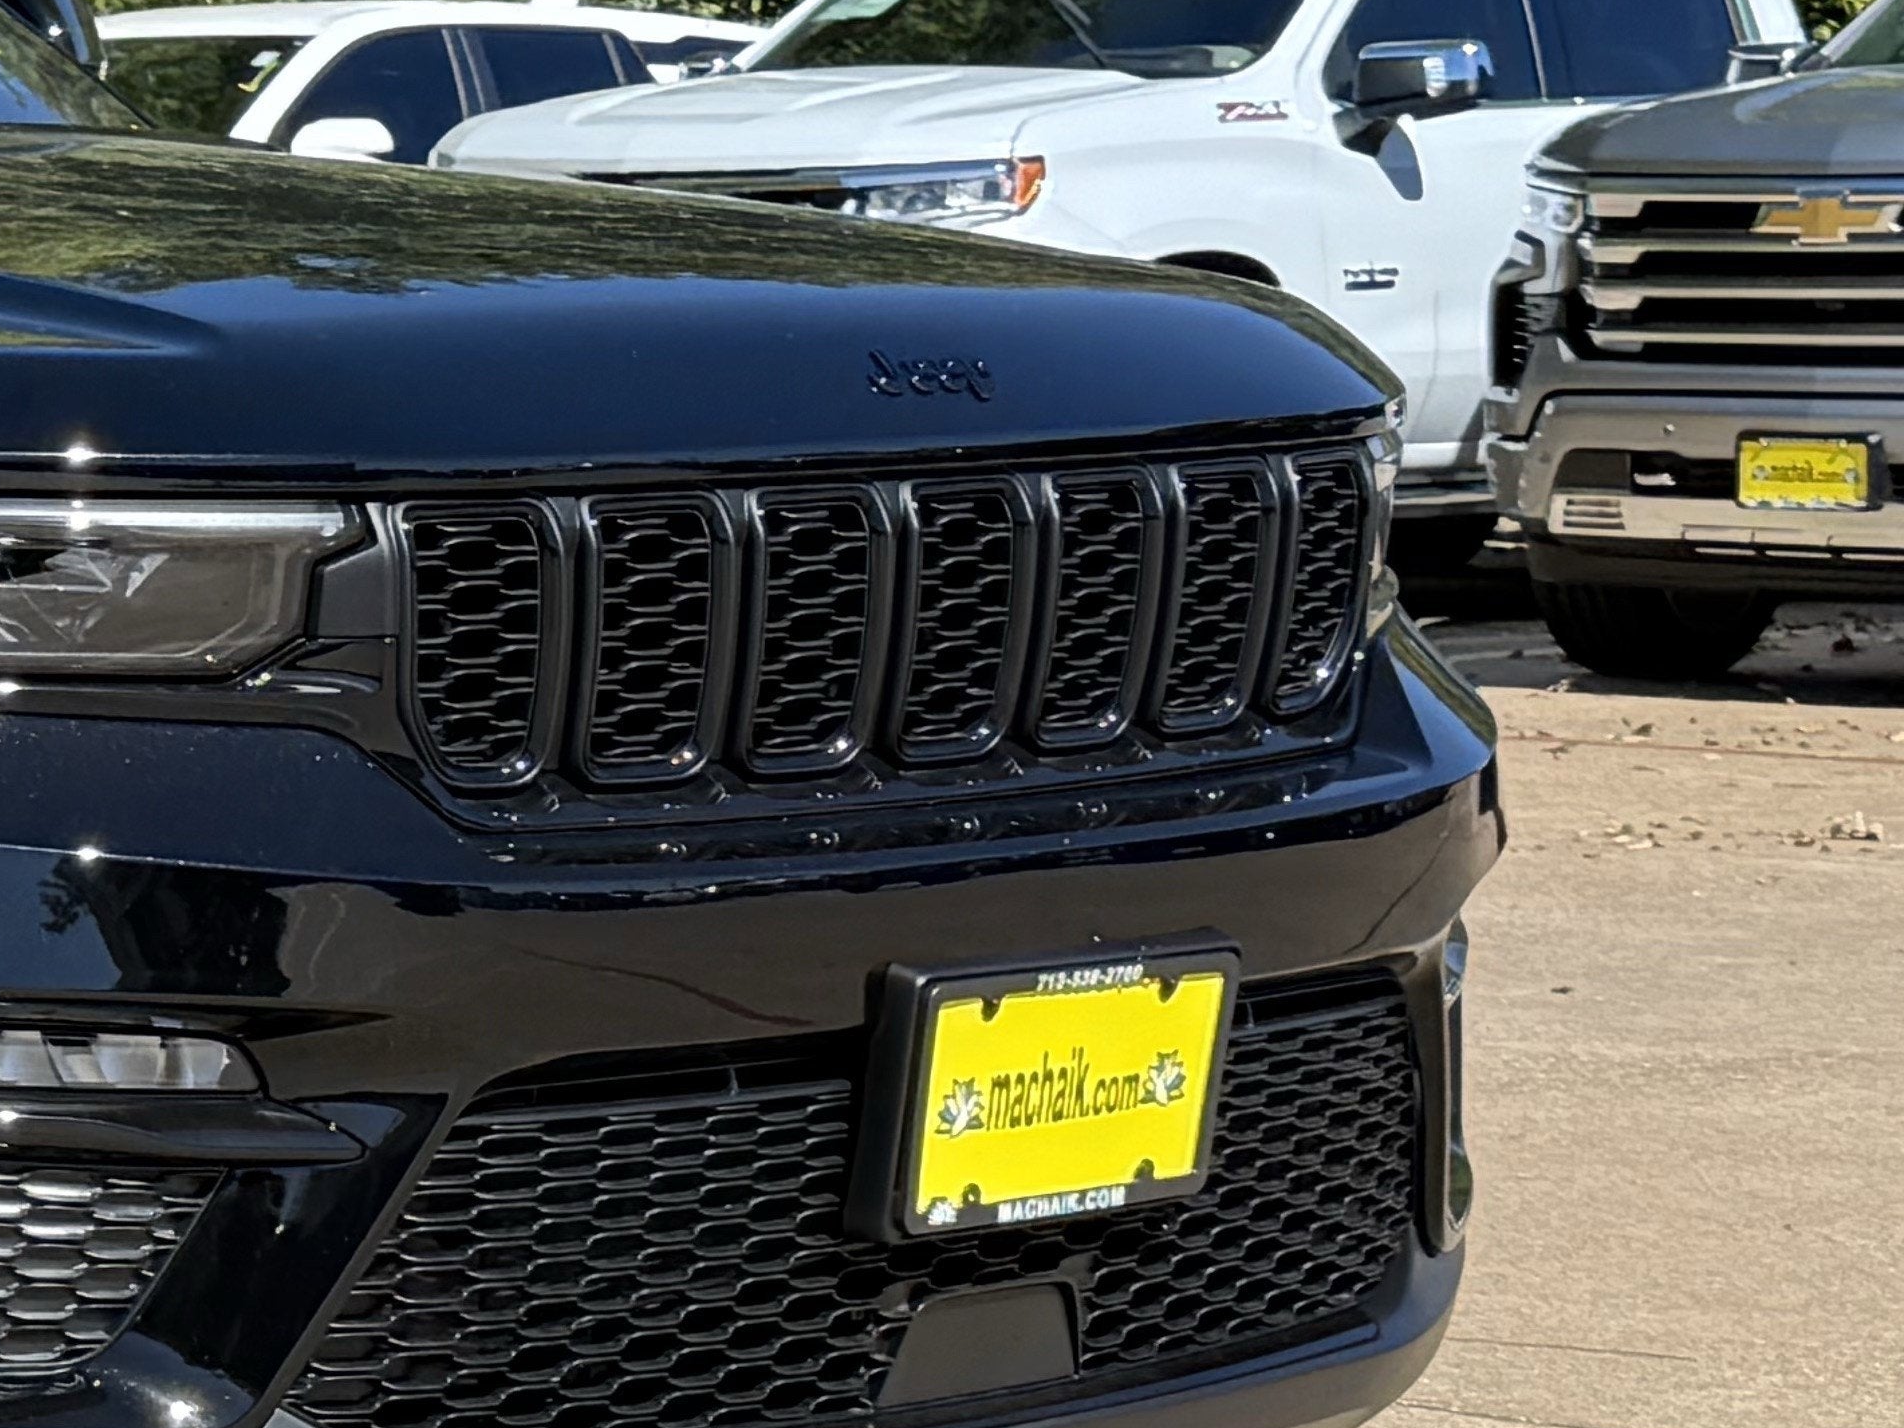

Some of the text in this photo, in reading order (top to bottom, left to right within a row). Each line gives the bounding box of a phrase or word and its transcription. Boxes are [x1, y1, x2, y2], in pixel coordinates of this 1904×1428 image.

[867, 349, 991, 403] Jeep
[985, 1047, 1141, 1132] machaik.com
[997, 1184, 1127, 1224] MACHAIK.COM
